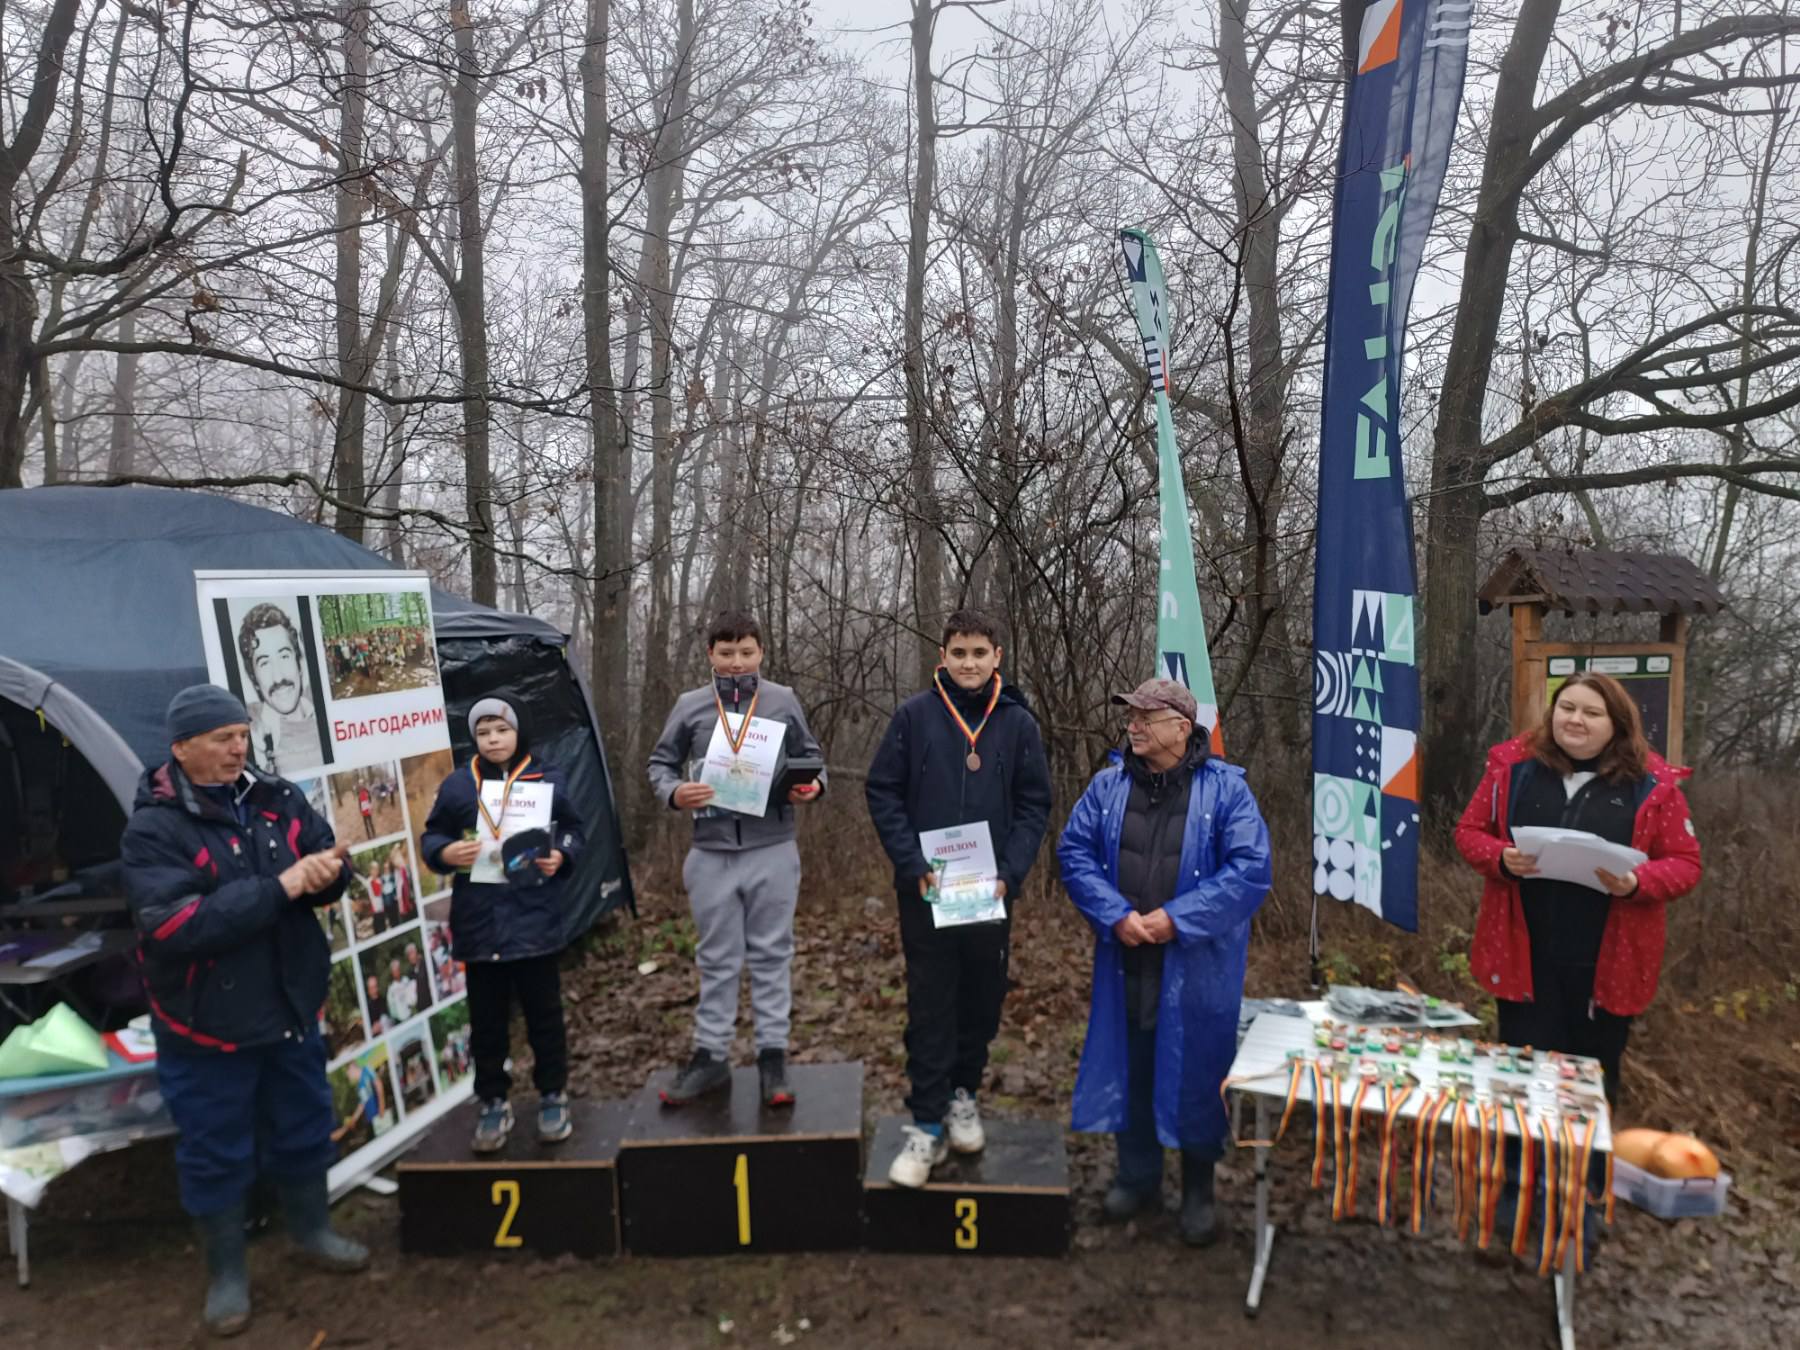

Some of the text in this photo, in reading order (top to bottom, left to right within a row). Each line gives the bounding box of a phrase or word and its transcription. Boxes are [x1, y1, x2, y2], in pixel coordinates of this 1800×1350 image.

[334, 708, 444, 742] БЛАГОДАРИМ
[727, 727, 768, 743] ИЛОМ
[934, 841, 978, 857] ДИПЛОМ
[491, 1180, 523, 1248] 2
[733, 1153, 752, 1246] 1
[955, 1198, 978, 1249] 3
